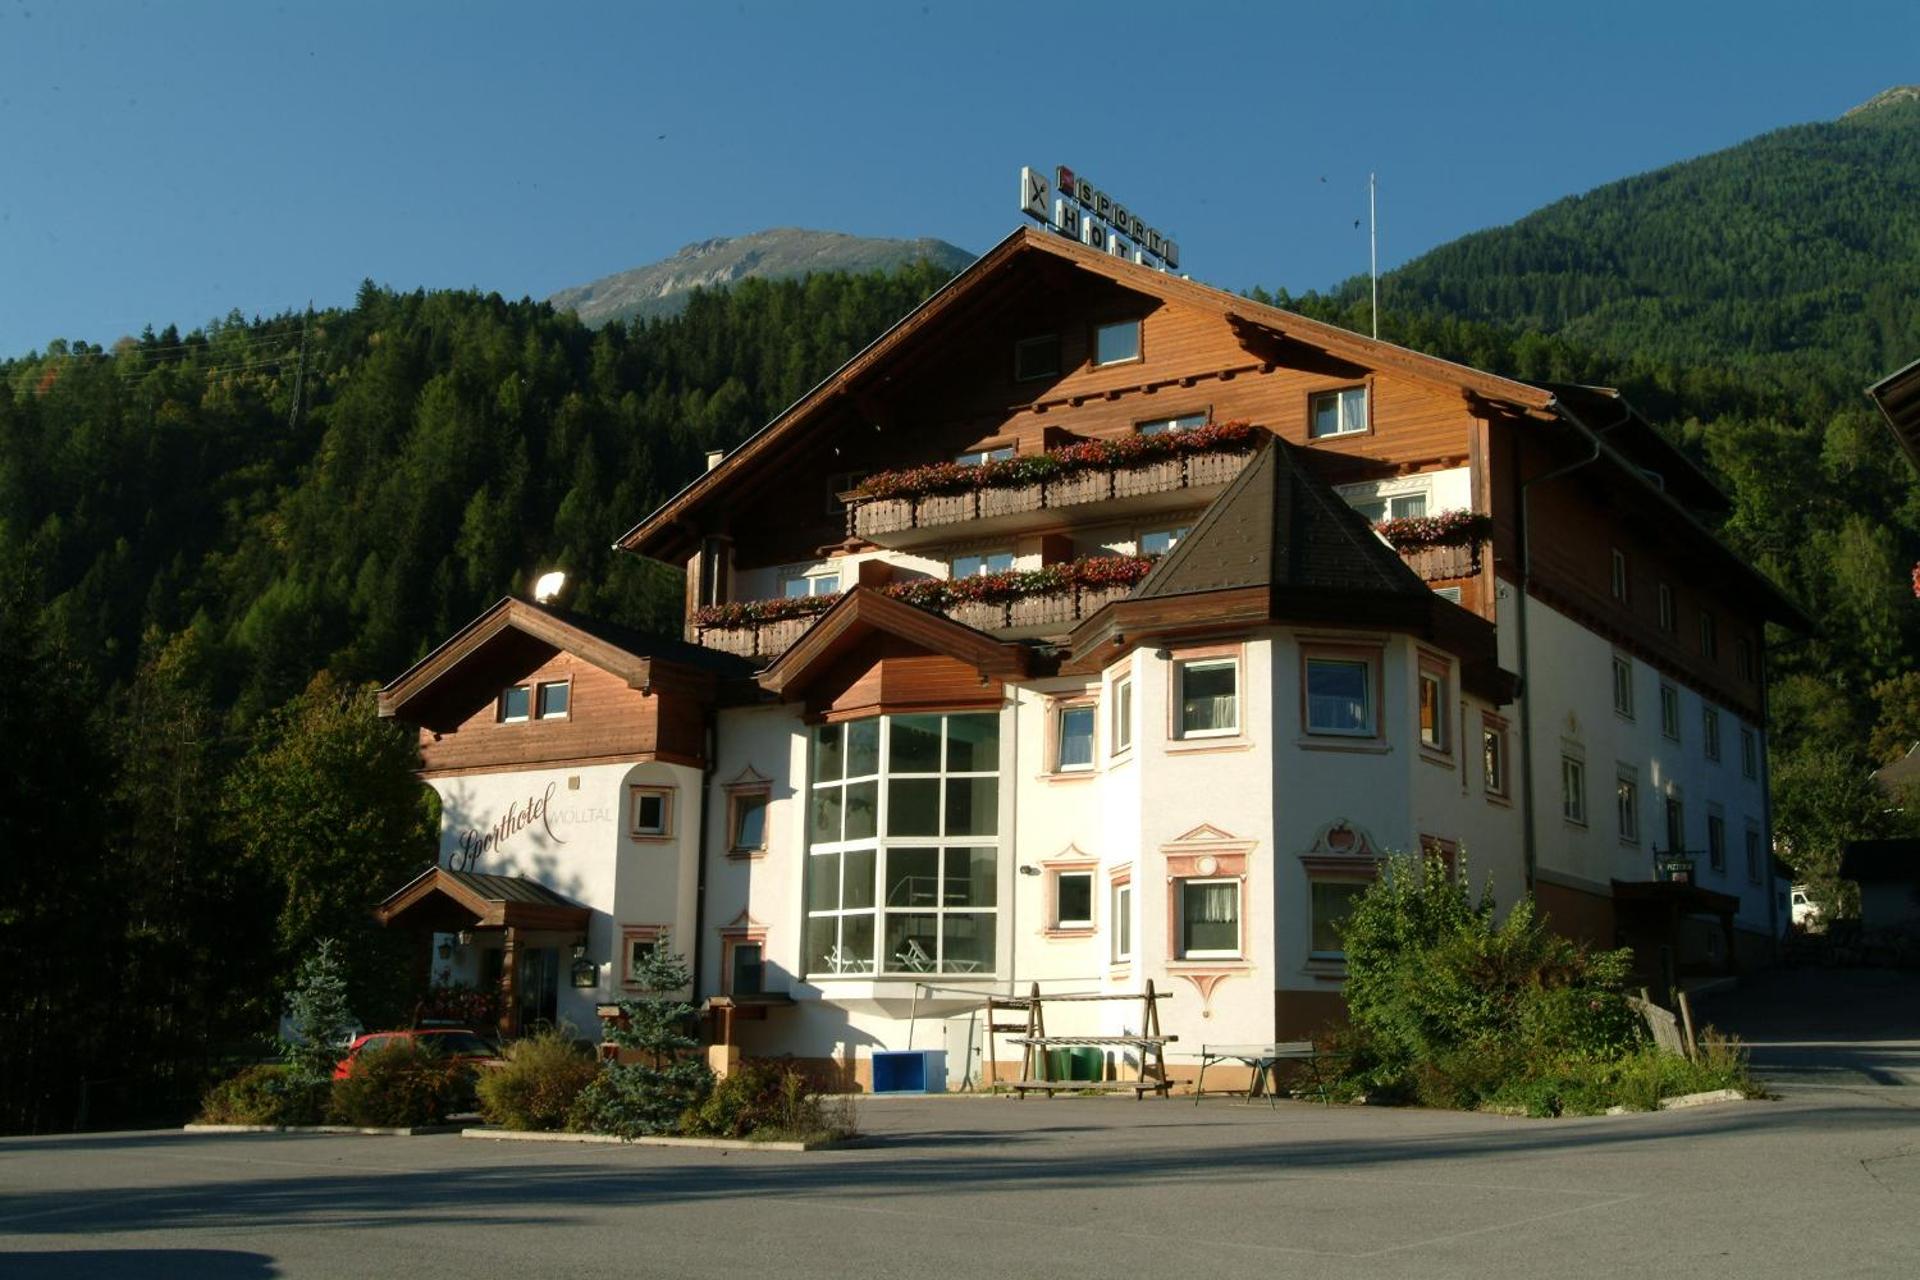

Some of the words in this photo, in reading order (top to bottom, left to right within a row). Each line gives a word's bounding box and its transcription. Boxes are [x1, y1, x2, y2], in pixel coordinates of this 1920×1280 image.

[1064, 207, 1151, 267] HOT
[1082, 184, 1162, 247] SPORT
[449, 781, 567, 872] Sporthotel
